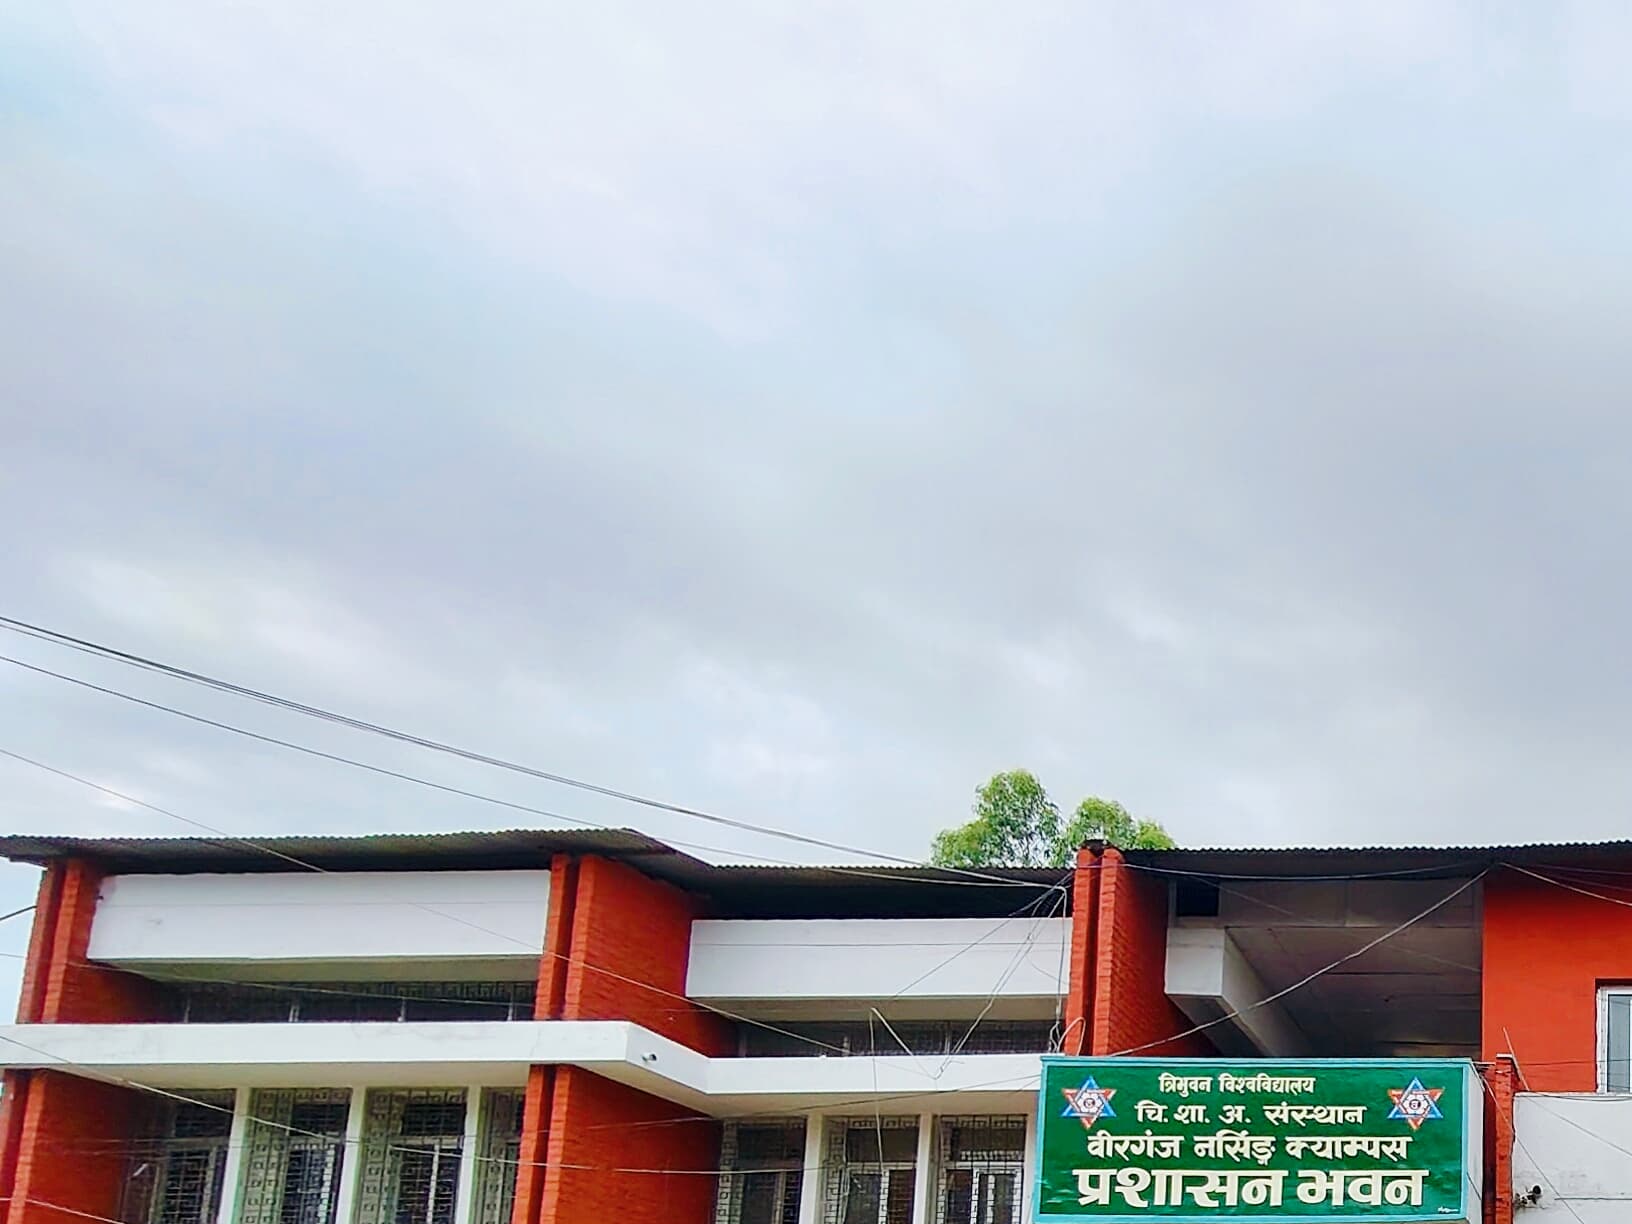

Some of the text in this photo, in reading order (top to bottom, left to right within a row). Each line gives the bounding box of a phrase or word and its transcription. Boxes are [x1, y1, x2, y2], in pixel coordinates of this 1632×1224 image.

[1158, 1072, 1316, 1097] त्रिभुवन विश्वविद्यालय
[1173, 1105, 1210, 1124] शा.
[1219, 1105, 1251, 1124] अ.
[1263, 1101, 1367, 1126] संस्थान
[1285, 1136, 1413, 1162] क्याम्पस
[1072, 1167, 1430, 1208] प्रशासन भवन
